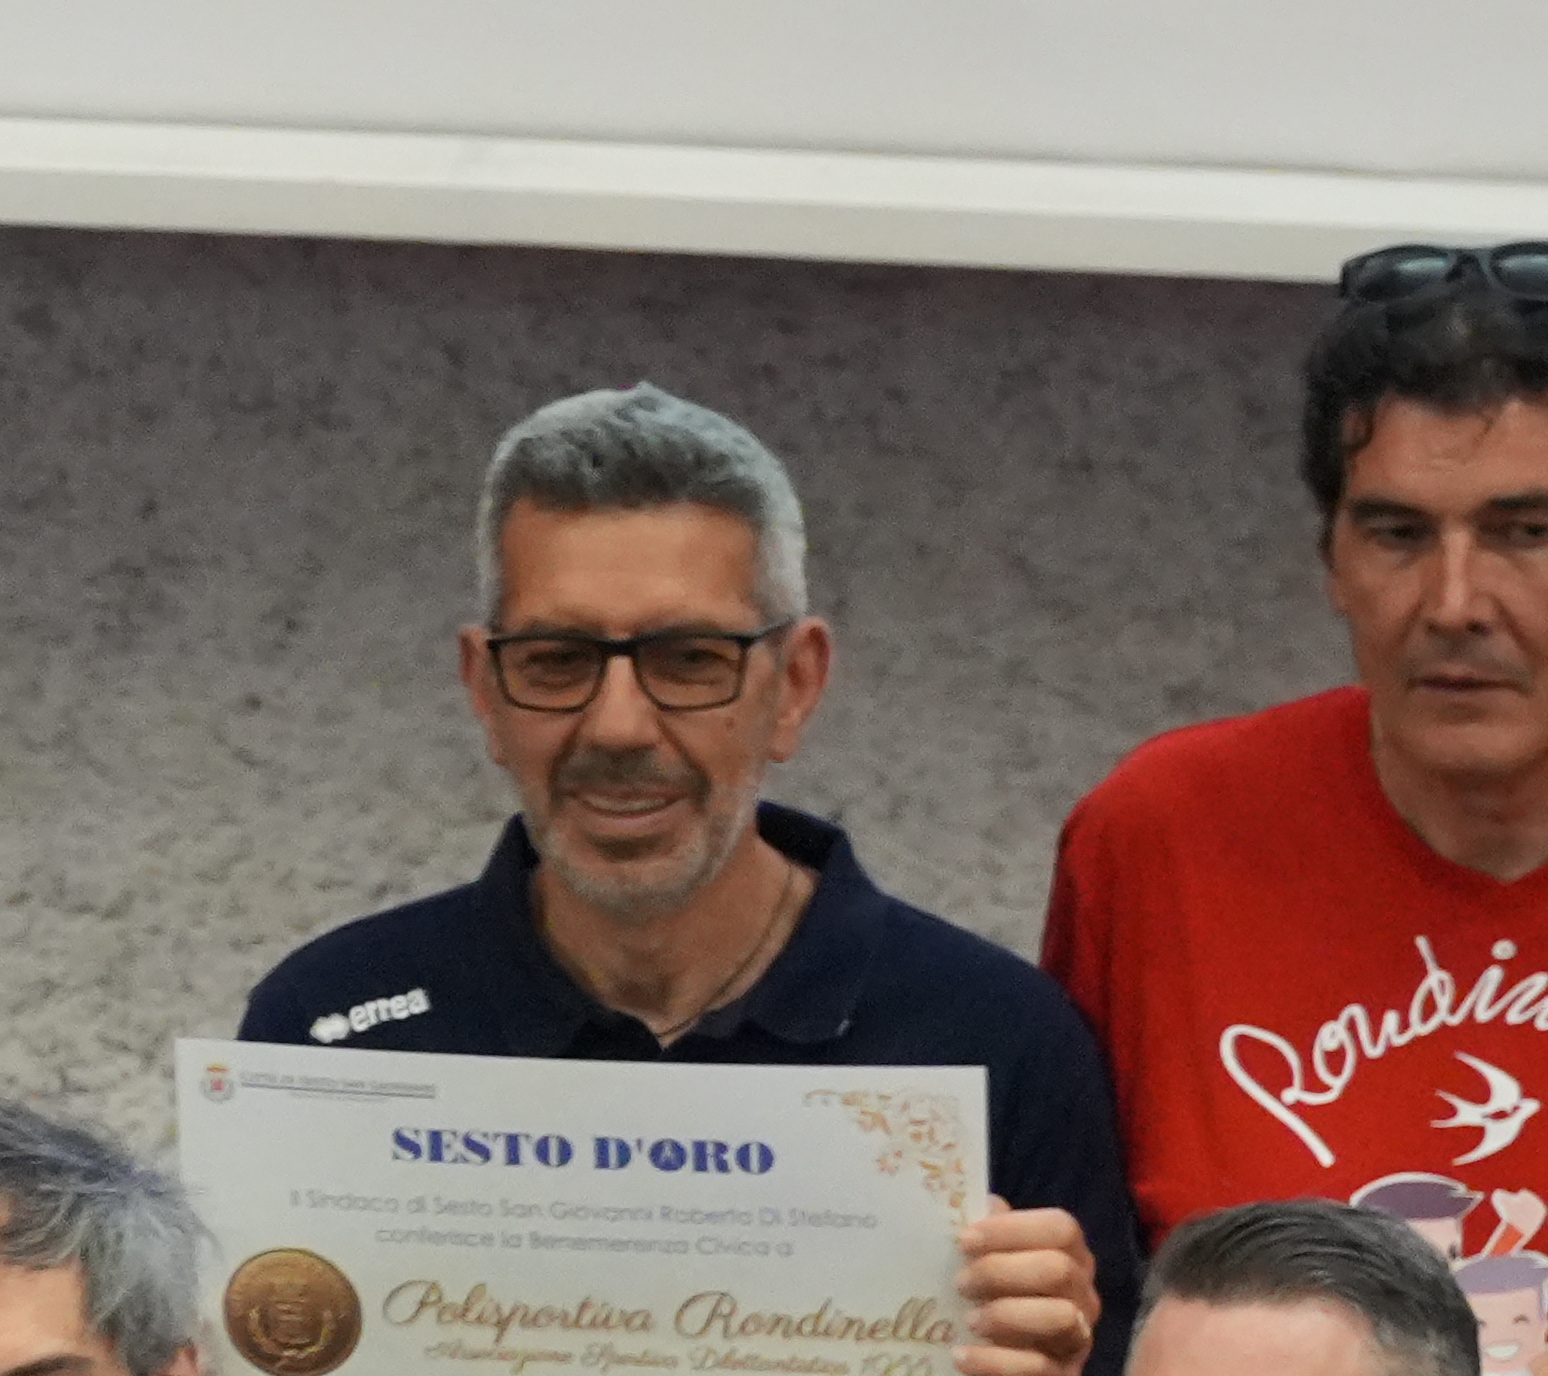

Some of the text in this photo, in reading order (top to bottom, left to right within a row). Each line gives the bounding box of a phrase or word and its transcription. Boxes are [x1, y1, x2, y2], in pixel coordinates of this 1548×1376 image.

[392, 1129, 775, 1174] SESTO D'ORO
[384, 1281, 956, 1347] Polisportiva Rondinella
